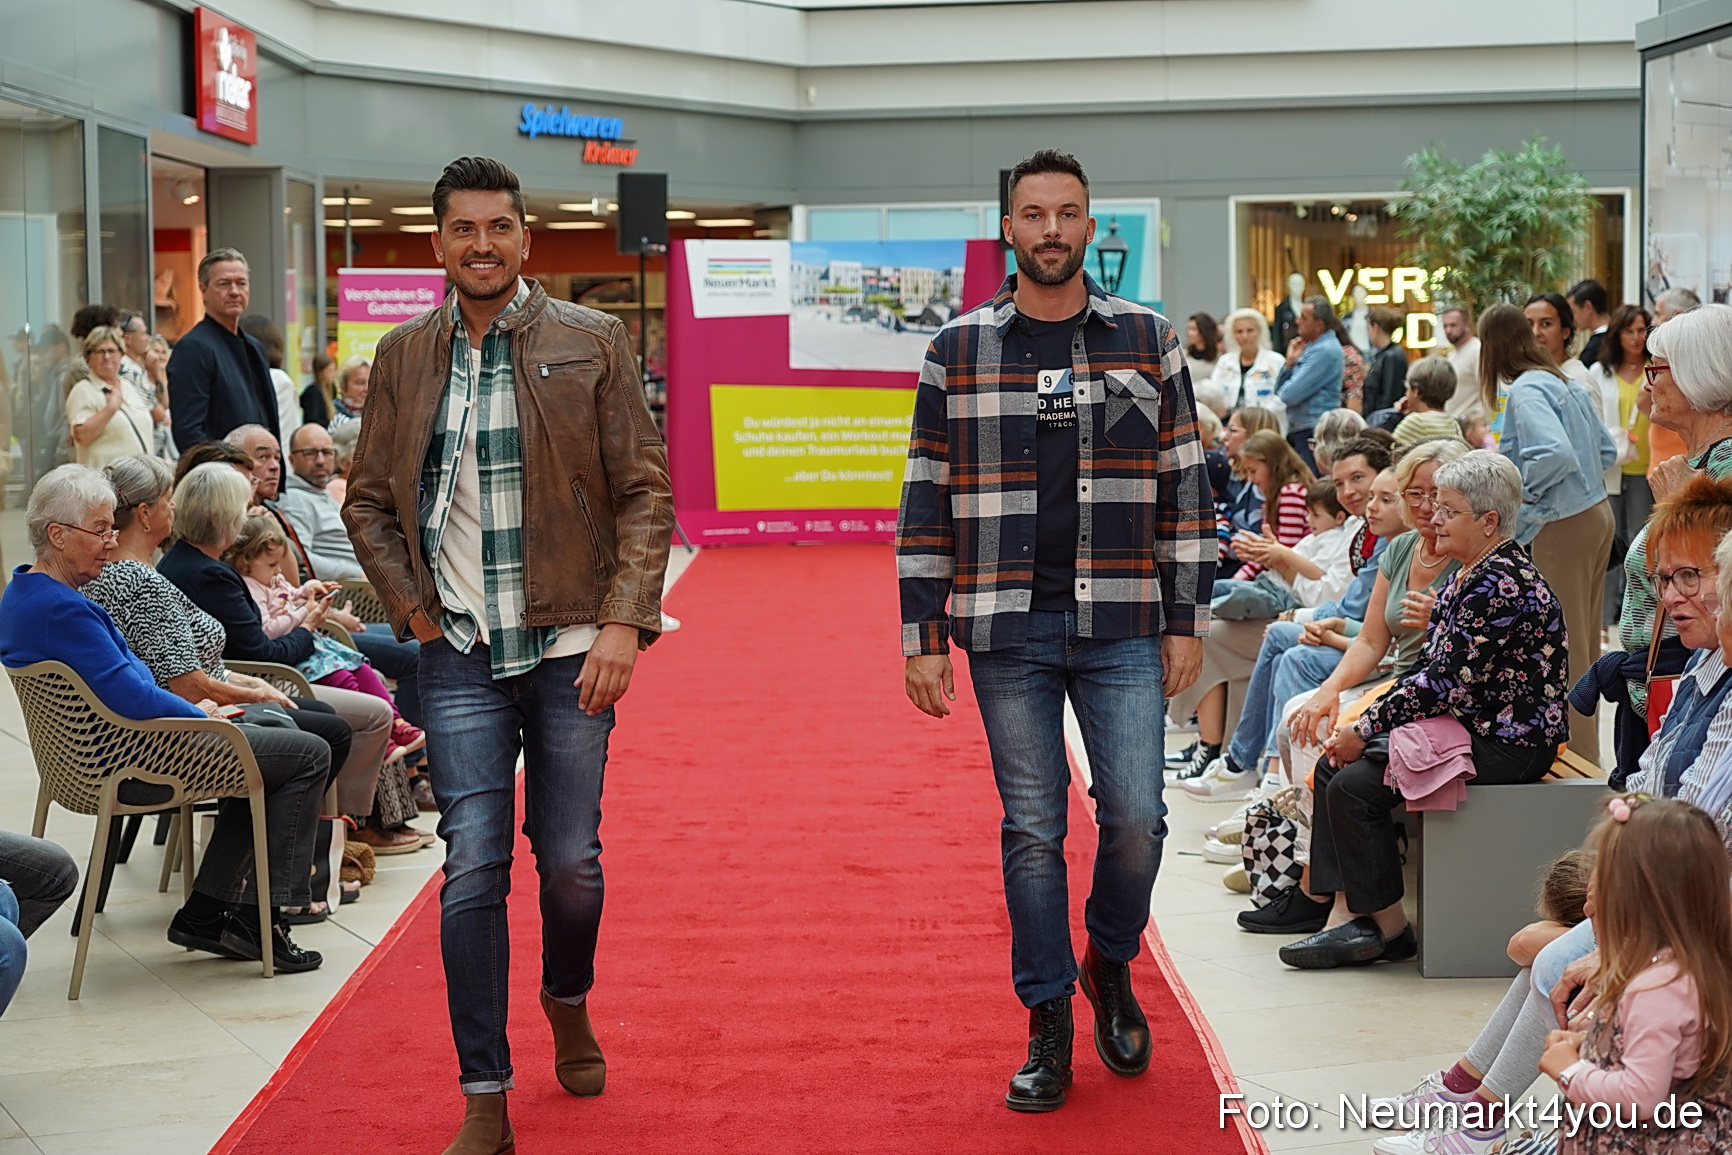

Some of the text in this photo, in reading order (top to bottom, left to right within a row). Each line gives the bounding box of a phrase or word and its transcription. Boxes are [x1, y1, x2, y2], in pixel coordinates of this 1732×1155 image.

[519, 103, 624, 139] Spielwaren
[704, 276, 776, 288] NeuerMarkt
[344, 288, 416, 302] Verschenken
[821, 415, 851, 428] nicht
[734, 430, 774, 443] Schuhe
[820, 430, 839, 442] ein
[841, 430, 888, 442] Workout
[742, 445, 766, 457] und
[766, 445, 806, 457] deinen
[807, 444, 879, 456] Traumurlaub
[820, 469, 837, 481] Du
